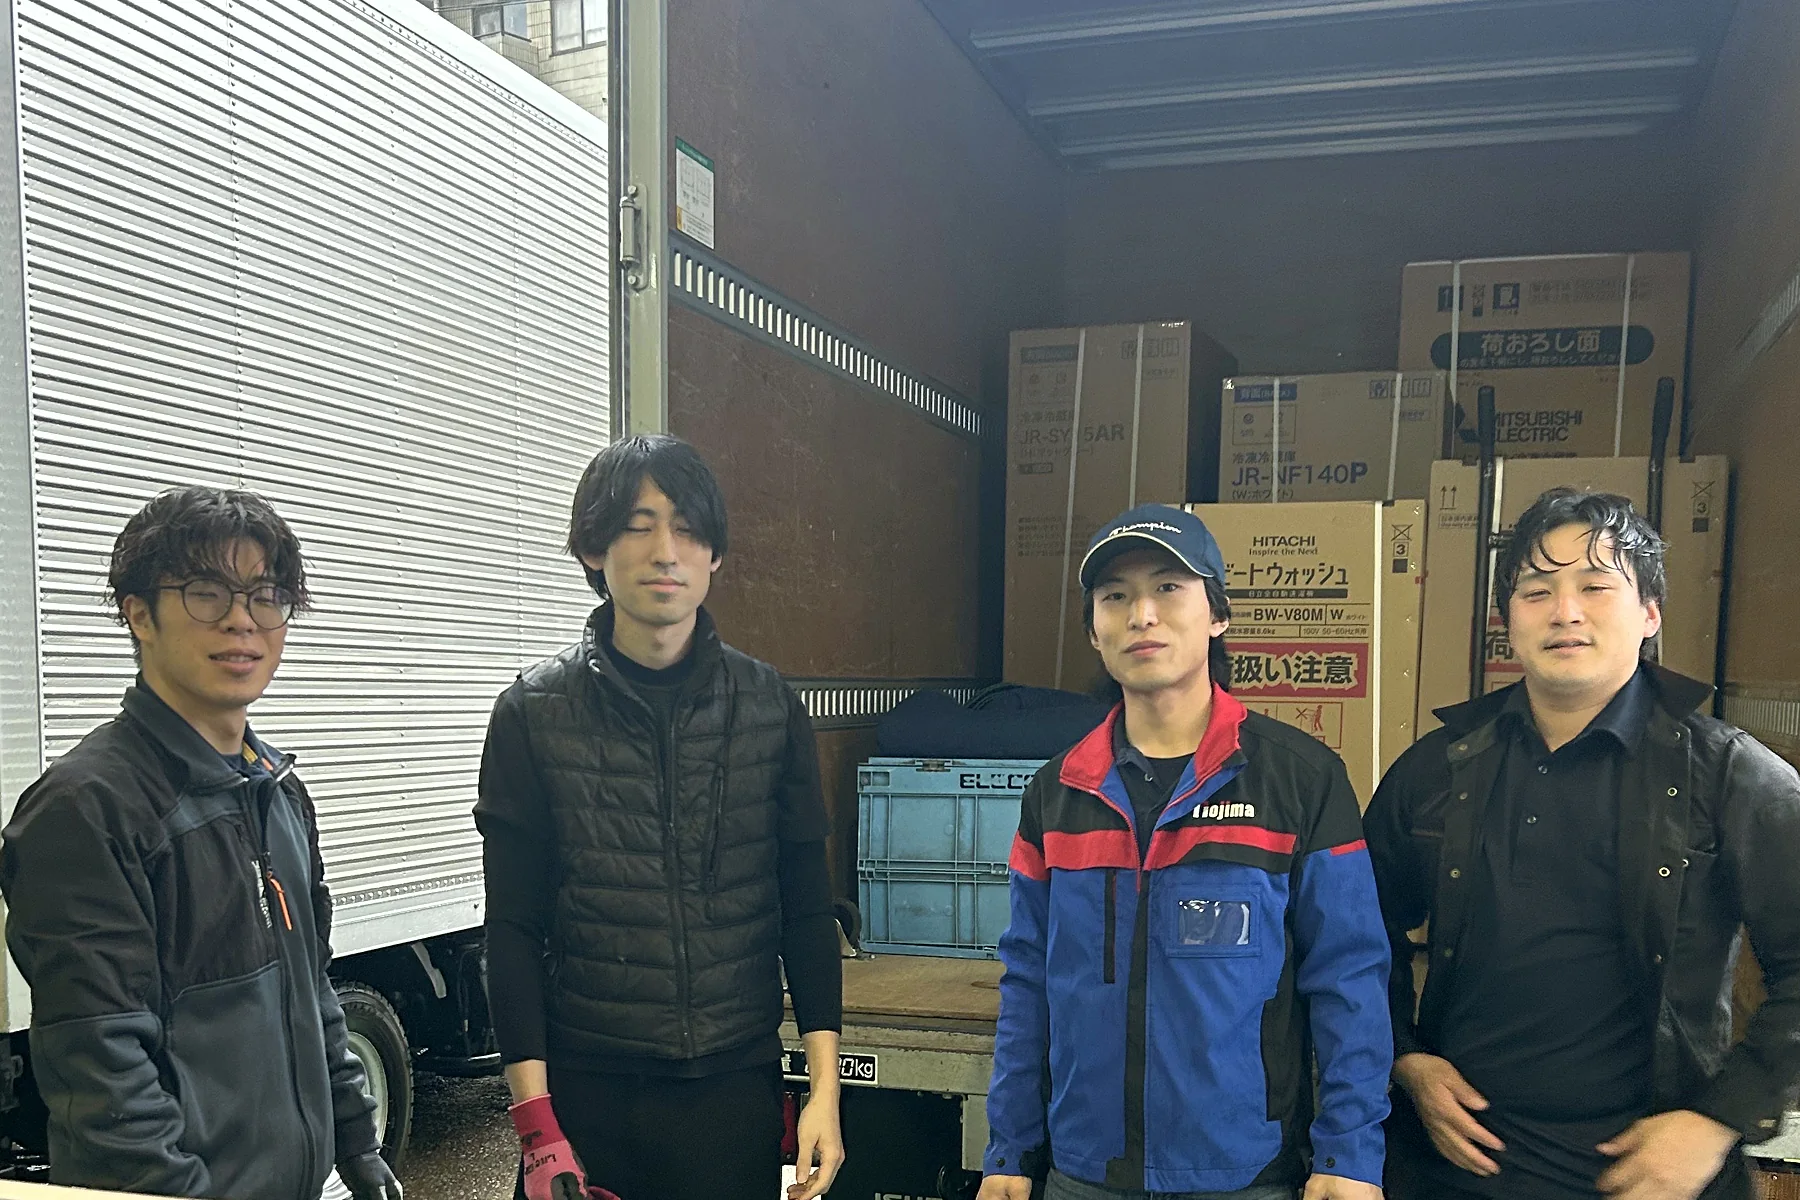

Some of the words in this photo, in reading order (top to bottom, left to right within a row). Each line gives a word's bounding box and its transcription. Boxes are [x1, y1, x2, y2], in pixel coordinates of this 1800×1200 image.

[1480, 330, 1601, 357] 荷おろし面
[1020, 423, 1125, 445] JR-SY5AR
[1496, 427, 1569, 443] LECTRIC
[1232, 462, 1368, 486] JR-NF140P
[1109, 522, 1182, 537] Champion
[1252, 535, 1316, 547] HITACHI
[1249, 547, 1280, 557] Inspire
[1281, 547, 1296, 556] the
[1298, 547, 1318, 556] Next
[1396, 544, 1406, 555] 3
[1253, 608, 1323, 621] BW-V80M
[1330, 609, 1344, 620] W
[1229, 655, 1353, 684] 扱い注意
